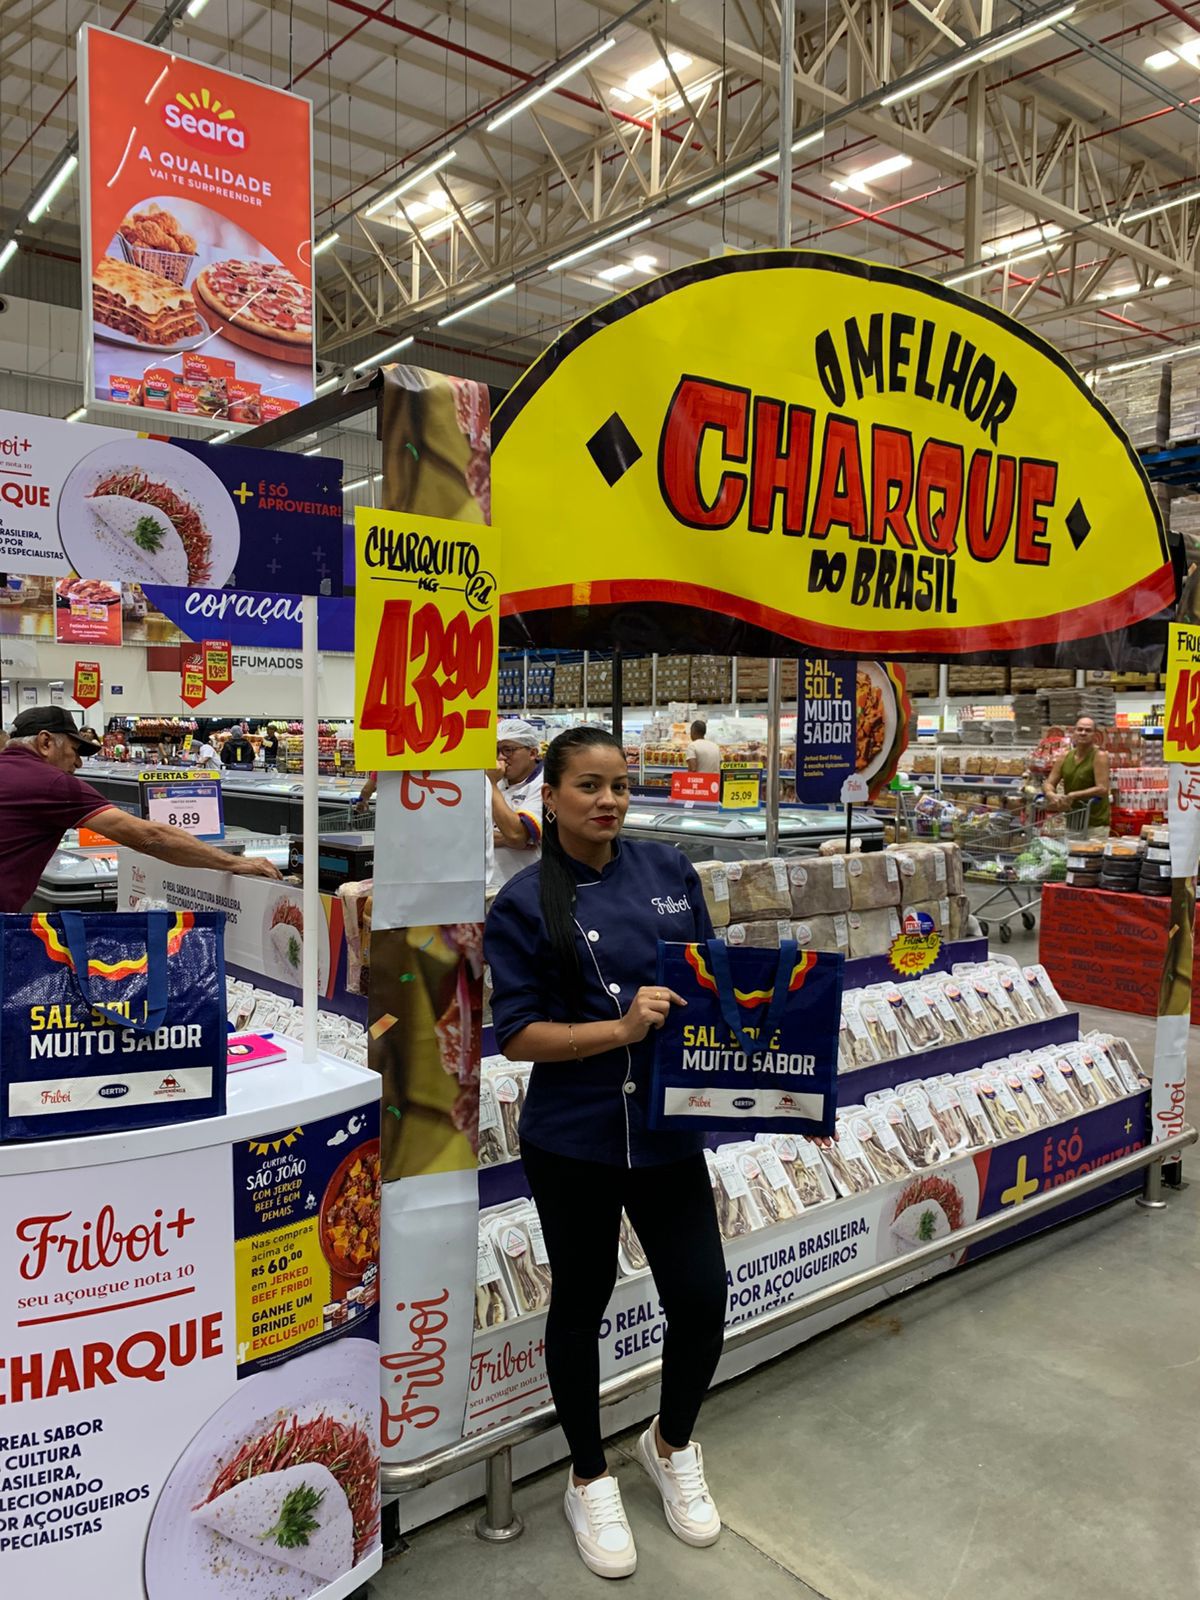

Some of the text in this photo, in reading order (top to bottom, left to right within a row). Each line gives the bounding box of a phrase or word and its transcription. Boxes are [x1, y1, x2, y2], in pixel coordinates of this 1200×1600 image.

[165, 104, 245, 149] Seara
[139, 145, 272, 197] A QUALIDADE
[149, 168, 263, 207] VAI TE SURPREENDER
[815, 312, 1018, 446] O MELHOR
[657, 373, 1059, 567] CHARQUE
[258, 480, 289, 497] É SÓ
[258, 499, 343, 518] APROVEITAR!
[7, 548, 64, 560] ESPECIALISTAS
[364, 525, 480, 579] CHARQUITO
[418, 577, 440, 593] KG
[807, 549, 958, 615] DO BRASIL
[805, 659, 836, 679] SAL,
[804, 677, 843, 699] SOL E
[804, 700, 852, 721] MUITO
[803, 722, 852, 744] SABOR
[143, 772, 189, 781] OFERTAS
[168, 812, 200, 828] 8,89
[176, 884, 190, 897] SABOR
[196, 889, 216, 903] CULTURA
[215, 893, 242, 913] BRASILEIRA,
[651, 894, 691, 915] Friboi
[30, 1003, 85, 1031] SAL,
[30, 1024, 202, 1059] MUITO SABOR
[683, 1025, 726, 1051] SAL,
[682, 1049, 816, 1076] MUITO SABOR
[40, 1089, 72, 1105] Friboi
[101, 1085, 127, 1096] BERTIN
[262, 1154, 294, 1170] CURTIR O
[1043, 1127, 1083, 1172] É SÓ
[246, 1158, 307, 1191] SÃO JOÃO
[252, 1179, 303, 1203] COM JERKED
[254, 1190, 301, 1213] BEEF É BOM
[261, 1207, 294, 1223] DEMAIS.
[251, 1224, 314, 1251] Nas compras
[251, 1241, 295, 1263] acima de
[251, 1264, 265, 1278] R$
[251, 1265, 309, 1292] em JERKED
[616, 1303, 655, 1334] REAL
[736, 1246, 796, 1283] CULTURA
[799, 1216, 870, 1260] BRASILEIRA,
[730, 1283, 761, 1312] POR
[764, 1242, 858, 1298] AÇOUGUEIROS
[18, 1264, 195, 1310] seu açougue nota 10
[251, 1290, 278, 1305] BEEF
[252, 1300, 293, 1323] GANHE
[295, 1293, 313, 1309] UM
[251, 1316, 297, 1337] BRINDE
[251, 1316, 319, 1351] EXCLUSIVO!
[0, 1311, 223, 1406] HARQUE
[380, 1288, 450, 1448] Friboi
[469, 1398, 485, 1409] seu
[485, 1384, 519, 1407] açougue
[520, 1375, 538, 1390] nota
[44, 1419, 104, 1444] SABOR
[5, 1443, 82, 1471] CULTURA
[23, 1484, 150, 1530] AÇOUGUEIROS
